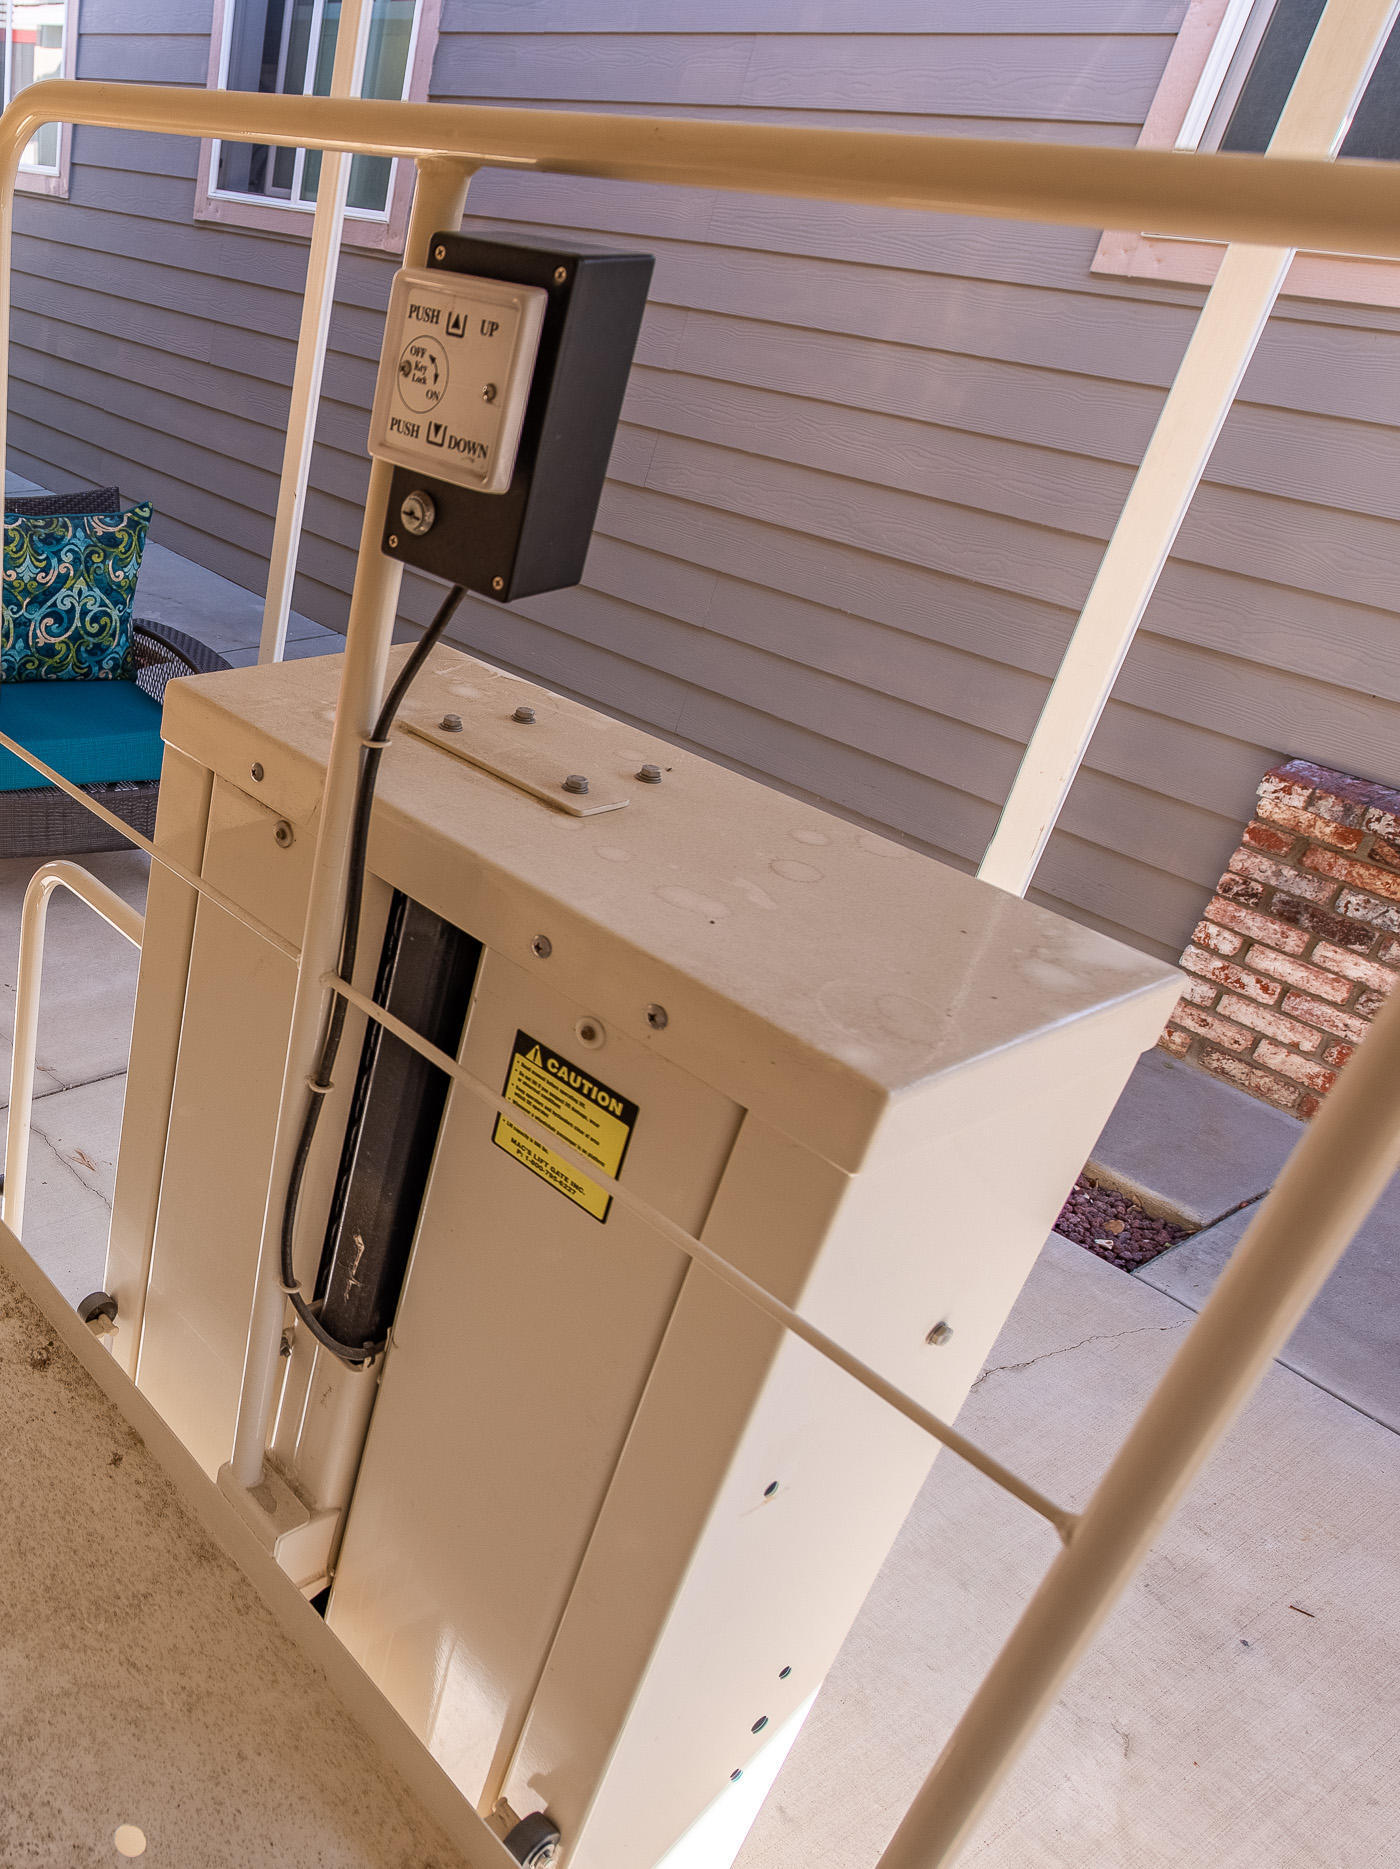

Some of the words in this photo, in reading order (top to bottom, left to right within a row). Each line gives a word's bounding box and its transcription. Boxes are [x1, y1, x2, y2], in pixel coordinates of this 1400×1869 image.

[408, 303, 441, 325] PUSH
[480, 319, 500, 337] UP
[410, 345, 427, 359] OFF
[414, 360, 428, 375] Key
[411, 373, 428, 385] Lock
[425, 389, 441, 401] ON
[389, 417, 421, 439] PUSH
[447, 434, 489, 459] DOWN
[546, 1057, 625, 1117] CAUTION
[533, 1153, 549, 1167] LIFT
[550, 1166, 570, 1183] GATE
